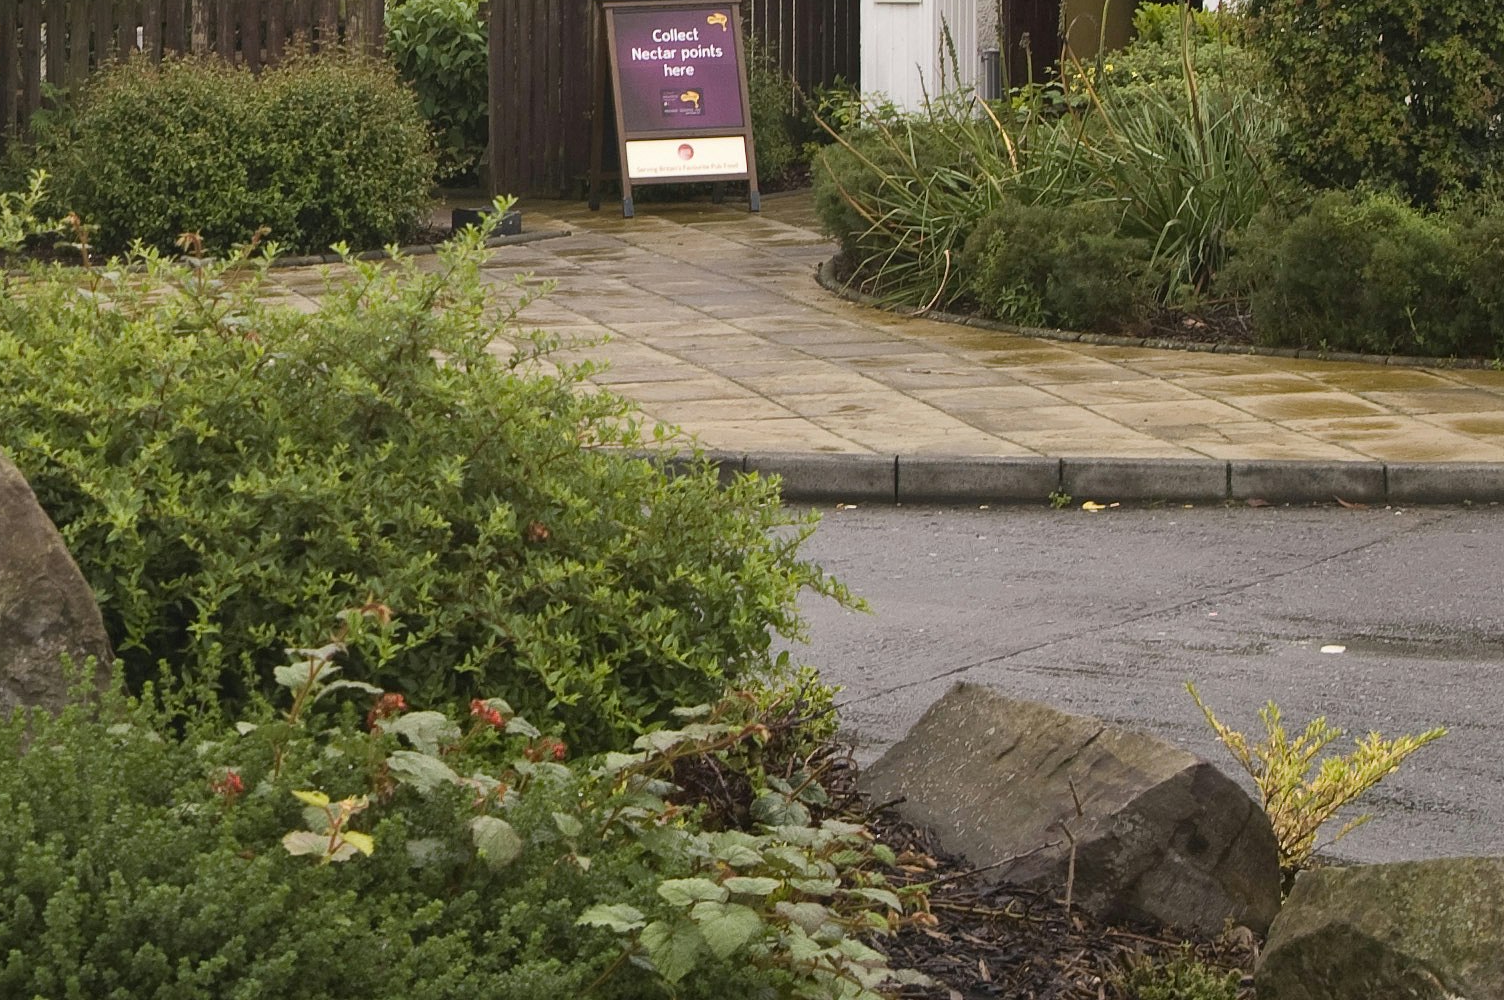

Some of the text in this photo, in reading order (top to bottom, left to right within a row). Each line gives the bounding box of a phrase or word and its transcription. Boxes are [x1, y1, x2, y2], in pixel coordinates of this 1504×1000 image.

[652, 28, 699, 42] Collect
[631, 44, 723, 61] Nectar points
[663, 64, 695, 77] here
